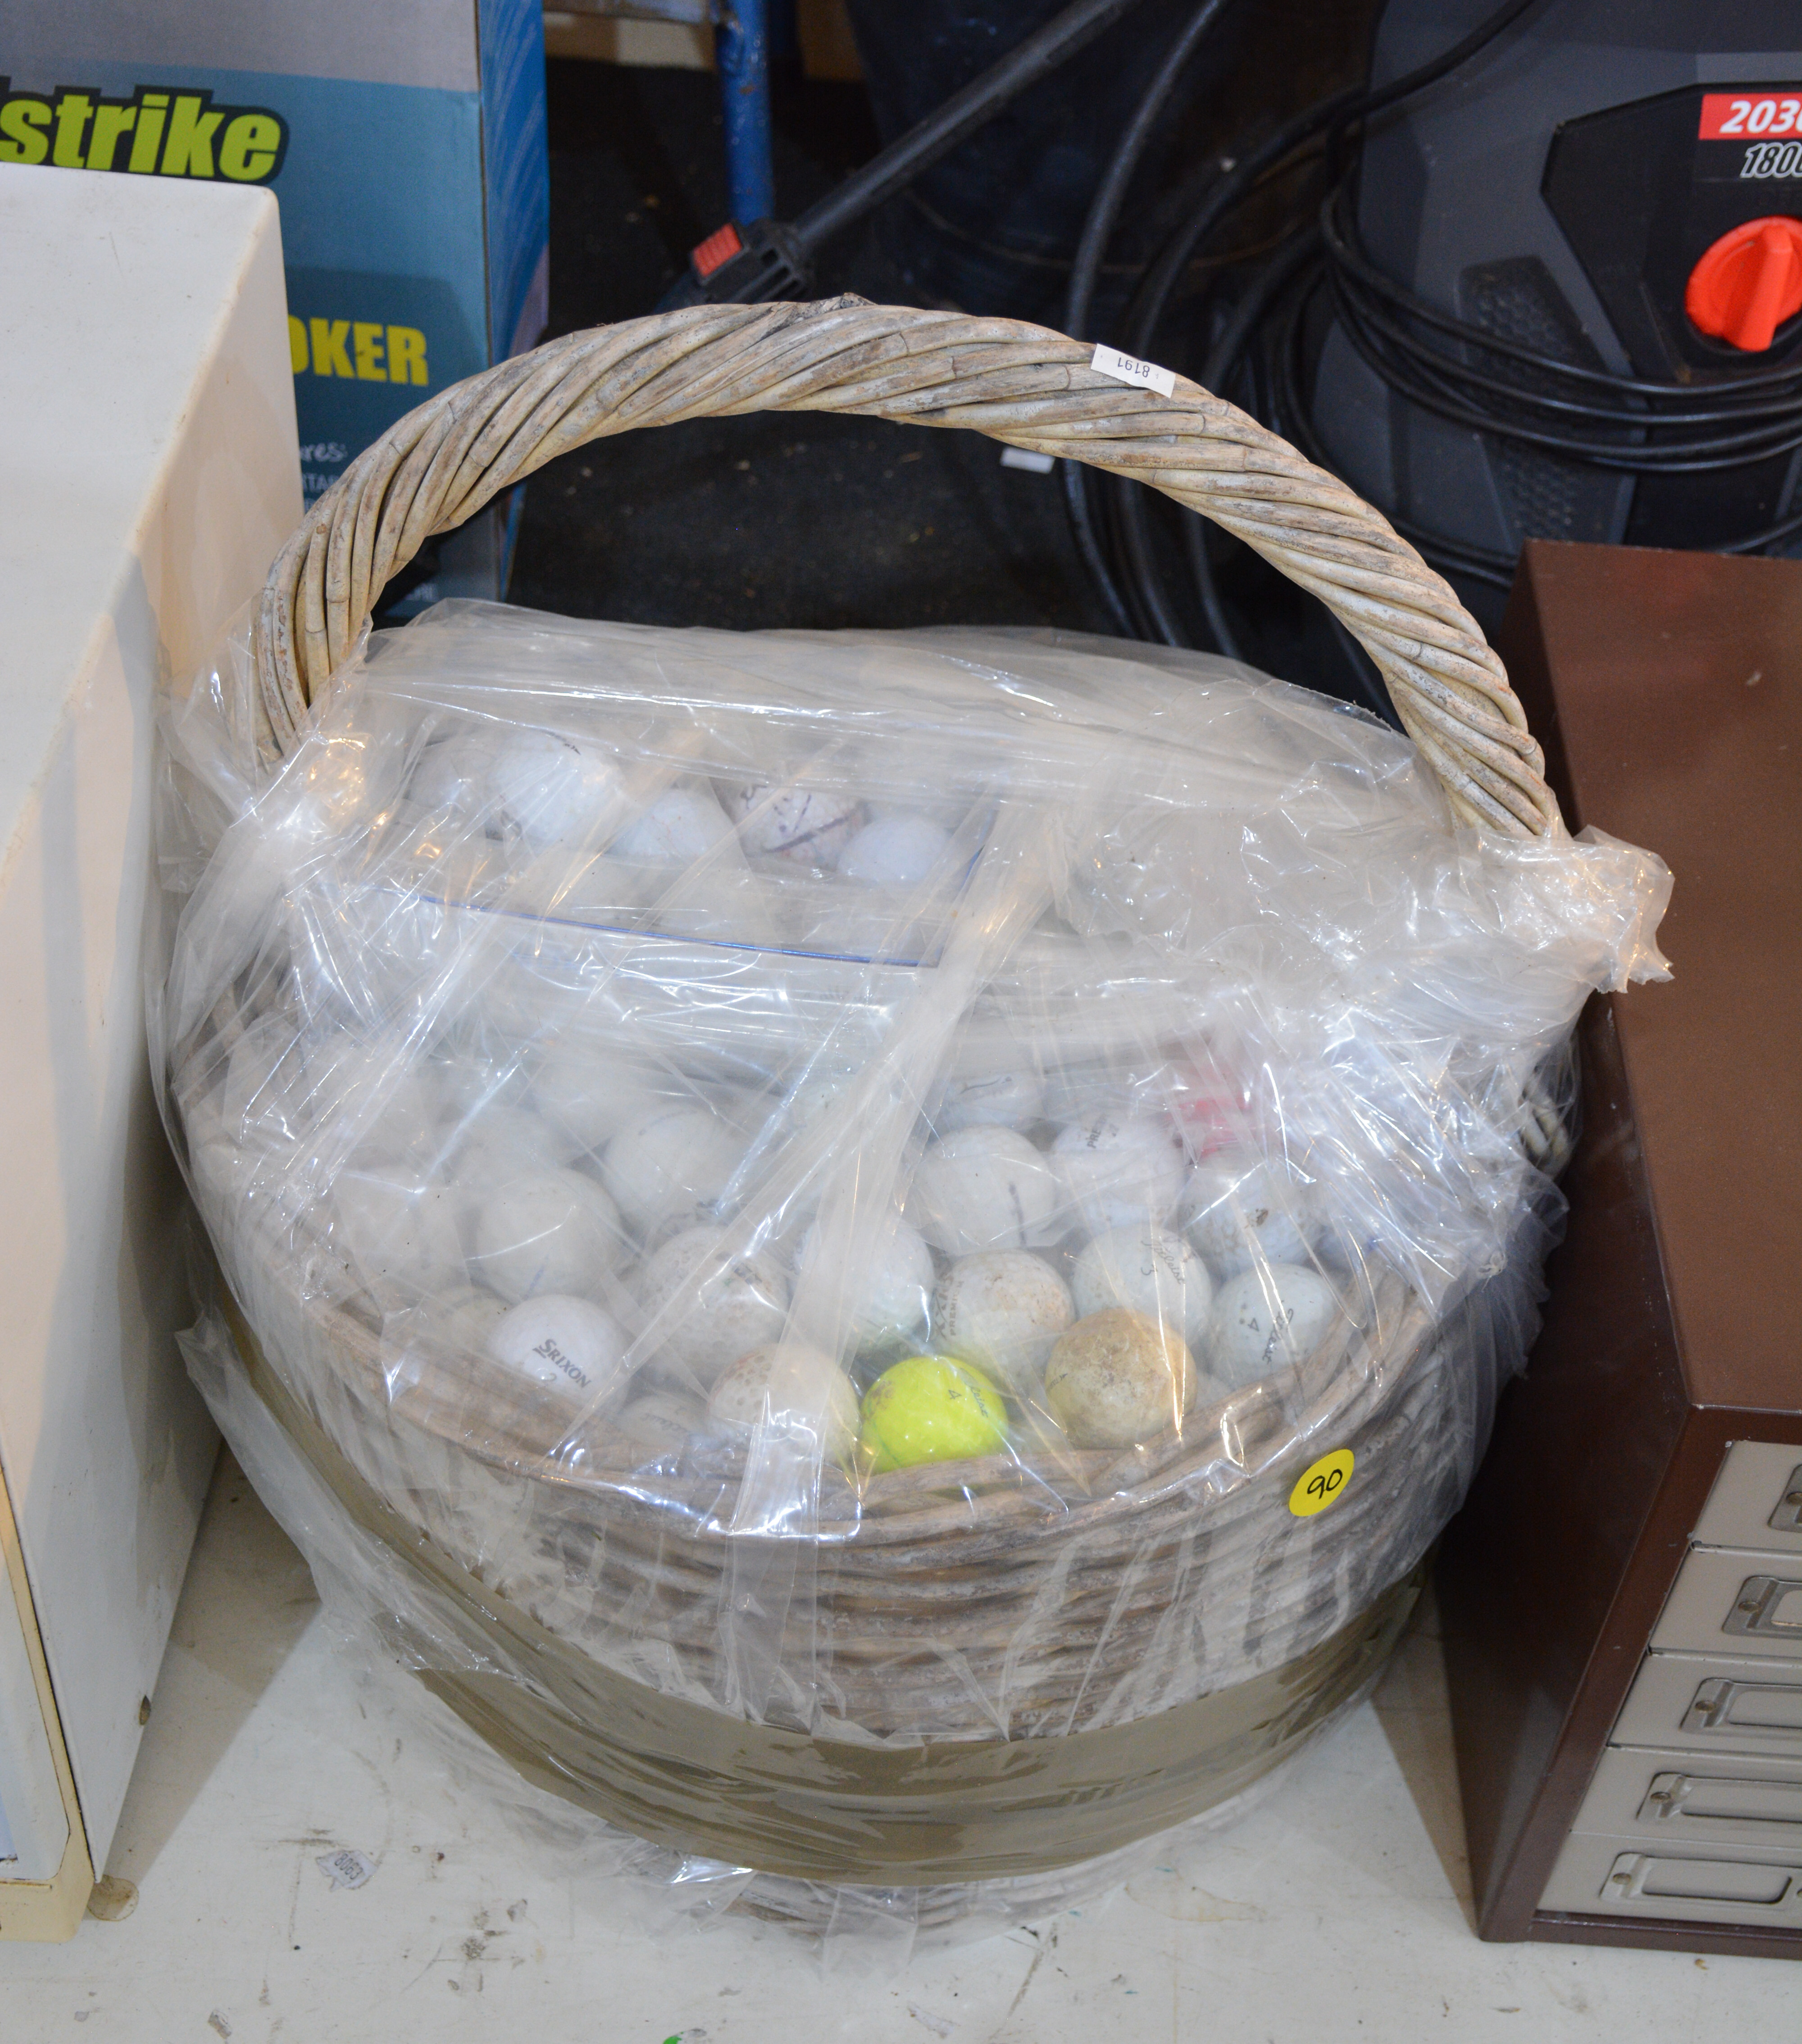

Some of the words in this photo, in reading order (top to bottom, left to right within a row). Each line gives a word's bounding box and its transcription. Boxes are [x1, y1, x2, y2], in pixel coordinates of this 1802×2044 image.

[1719, 99, 1802, 134] 203
[0, 93, 282, 181] strike
[1117, 357, 1150, 378] 8191
[1140, 1264, 1158, 1276] 3
[1247, 1317, 1260, 1332] 4
[532, 1338, 592, 1388] SRIXON
[947, 1389, 962, 1400] 4
[1307, 1468, 1343, 1500] 90
[334, 1853, 364, 1880] 8063
